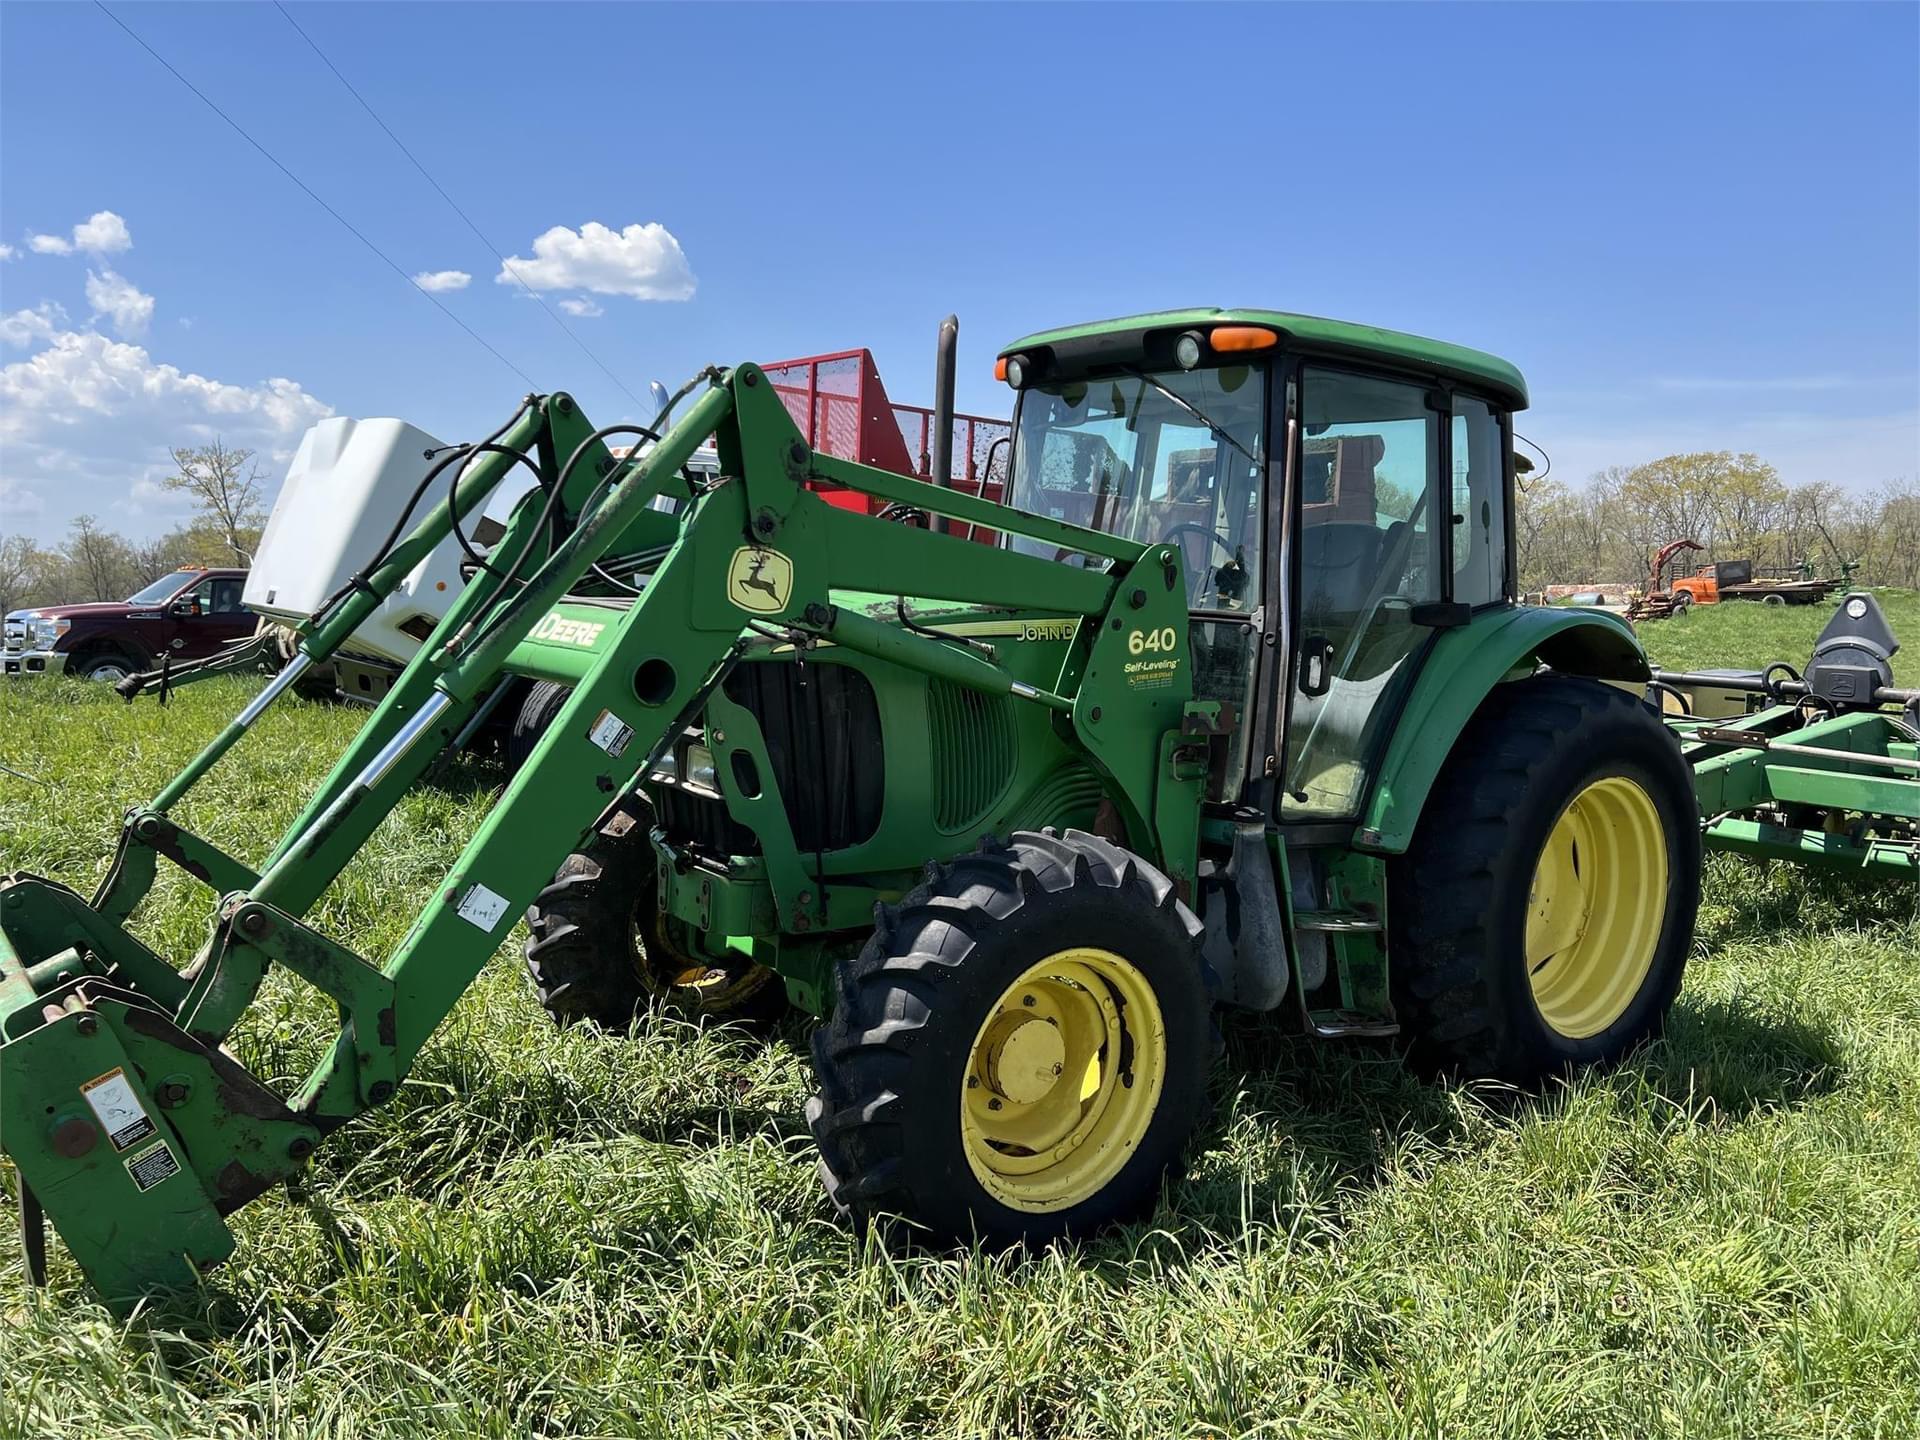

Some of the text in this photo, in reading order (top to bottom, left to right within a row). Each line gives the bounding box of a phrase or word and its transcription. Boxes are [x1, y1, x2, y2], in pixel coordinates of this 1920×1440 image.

[535, 612, 606, 647] DEERE
[1016, 623, 1060, 642] JOHN
[1128, 627, 1176, 655] 640
[134, 1143, 164, 1161] CAUTION
